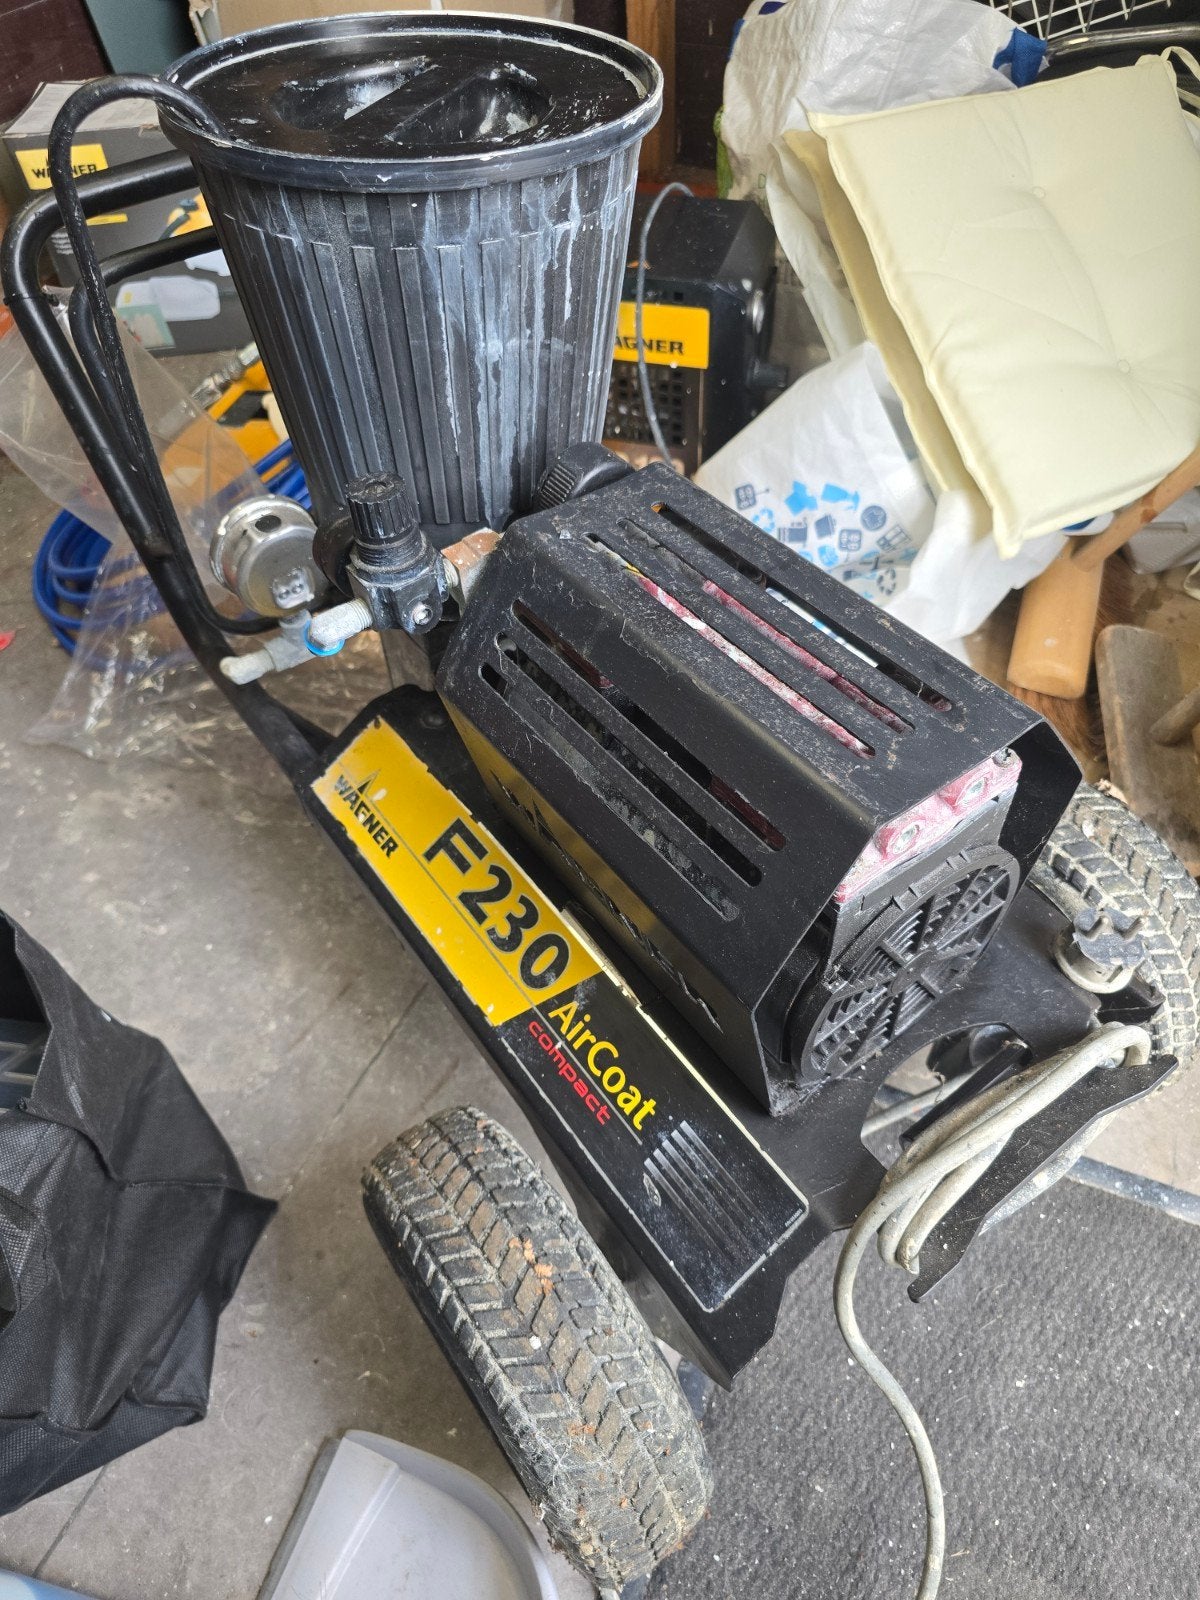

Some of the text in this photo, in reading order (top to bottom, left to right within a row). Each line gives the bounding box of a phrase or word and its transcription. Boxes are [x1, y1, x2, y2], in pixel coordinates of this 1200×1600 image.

[31, 164, 97, 178] WNER
[335, 775, 399, 859] WAGNER
[421, 817, 571, 990] F230
[528, 1021, 611, 1126] compact
[548, 1000, 656, 1131] AirCoat
